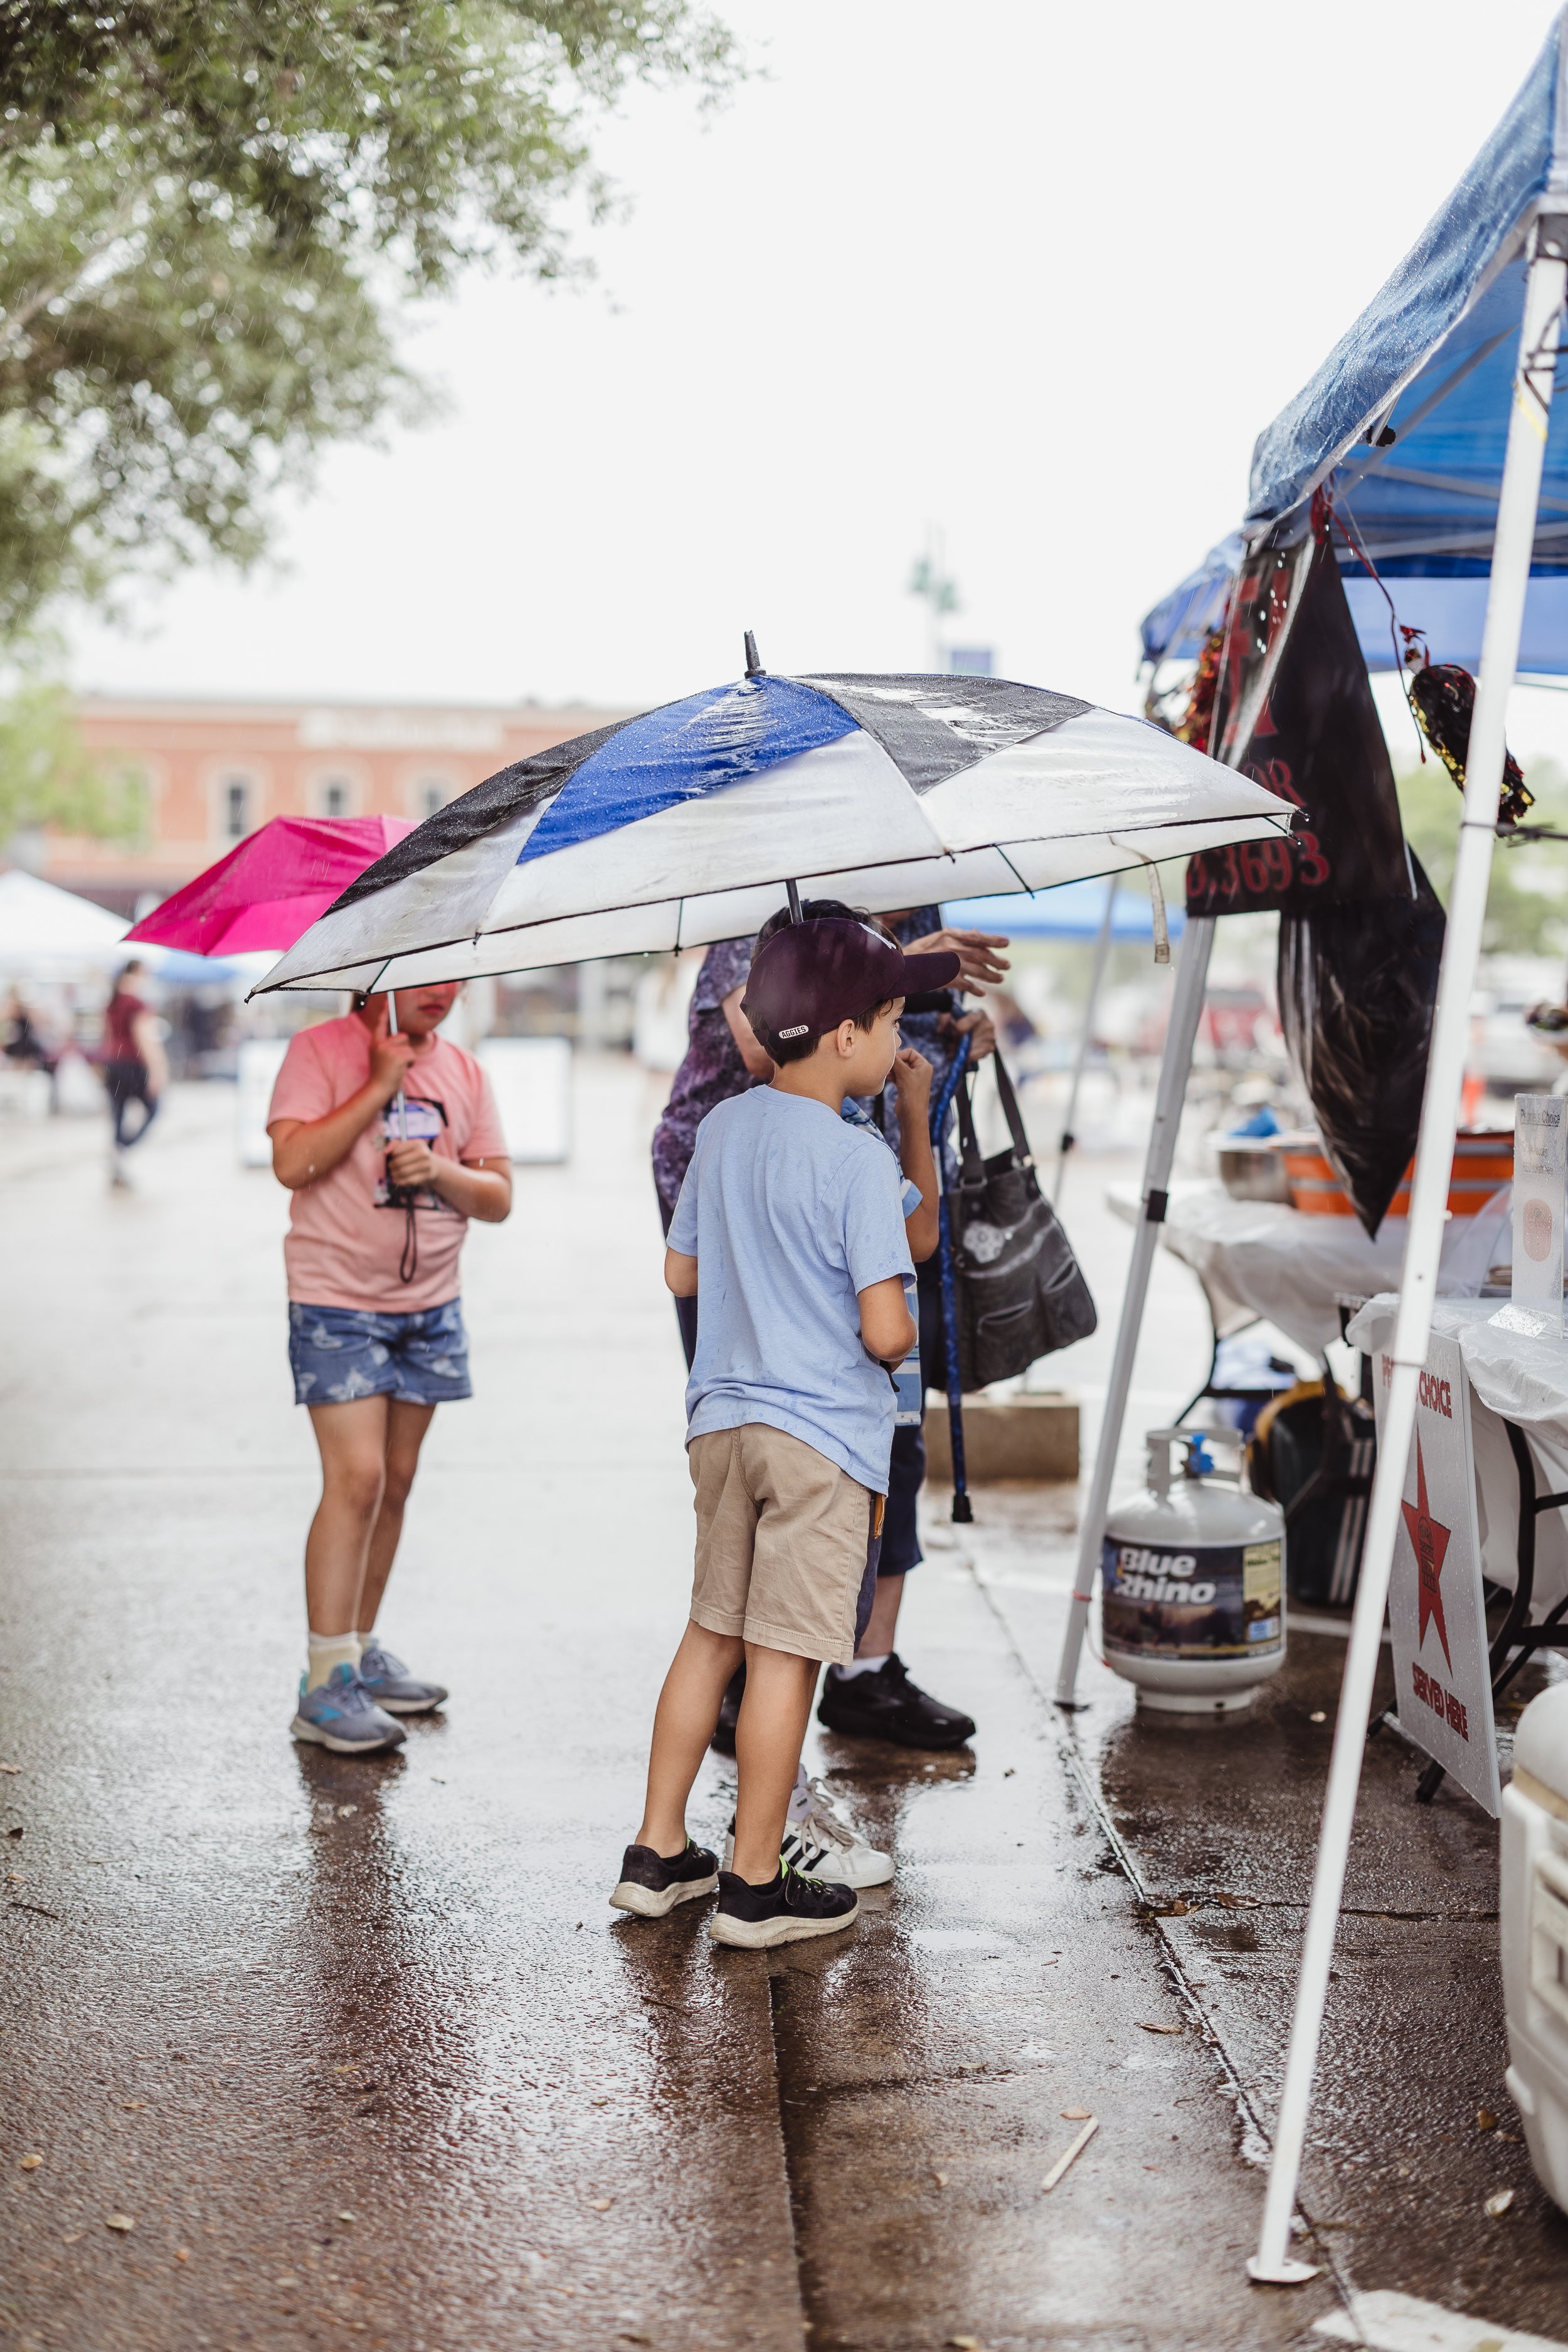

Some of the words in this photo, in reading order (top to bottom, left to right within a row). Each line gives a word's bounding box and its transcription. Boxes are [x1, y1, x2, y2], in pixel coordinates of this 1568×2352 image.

[781, 1026, 807, 1038] AGGIES
[1542, 1110, 1560, 1125] Choice
[1419, 1370, 1453, 1419] CHOICE
[1120, 1547, 1197, 1577] Blue
[1412, 1661, 1444, 1719] SERVED
[1444, 1688, 1470, 1743] HERE
